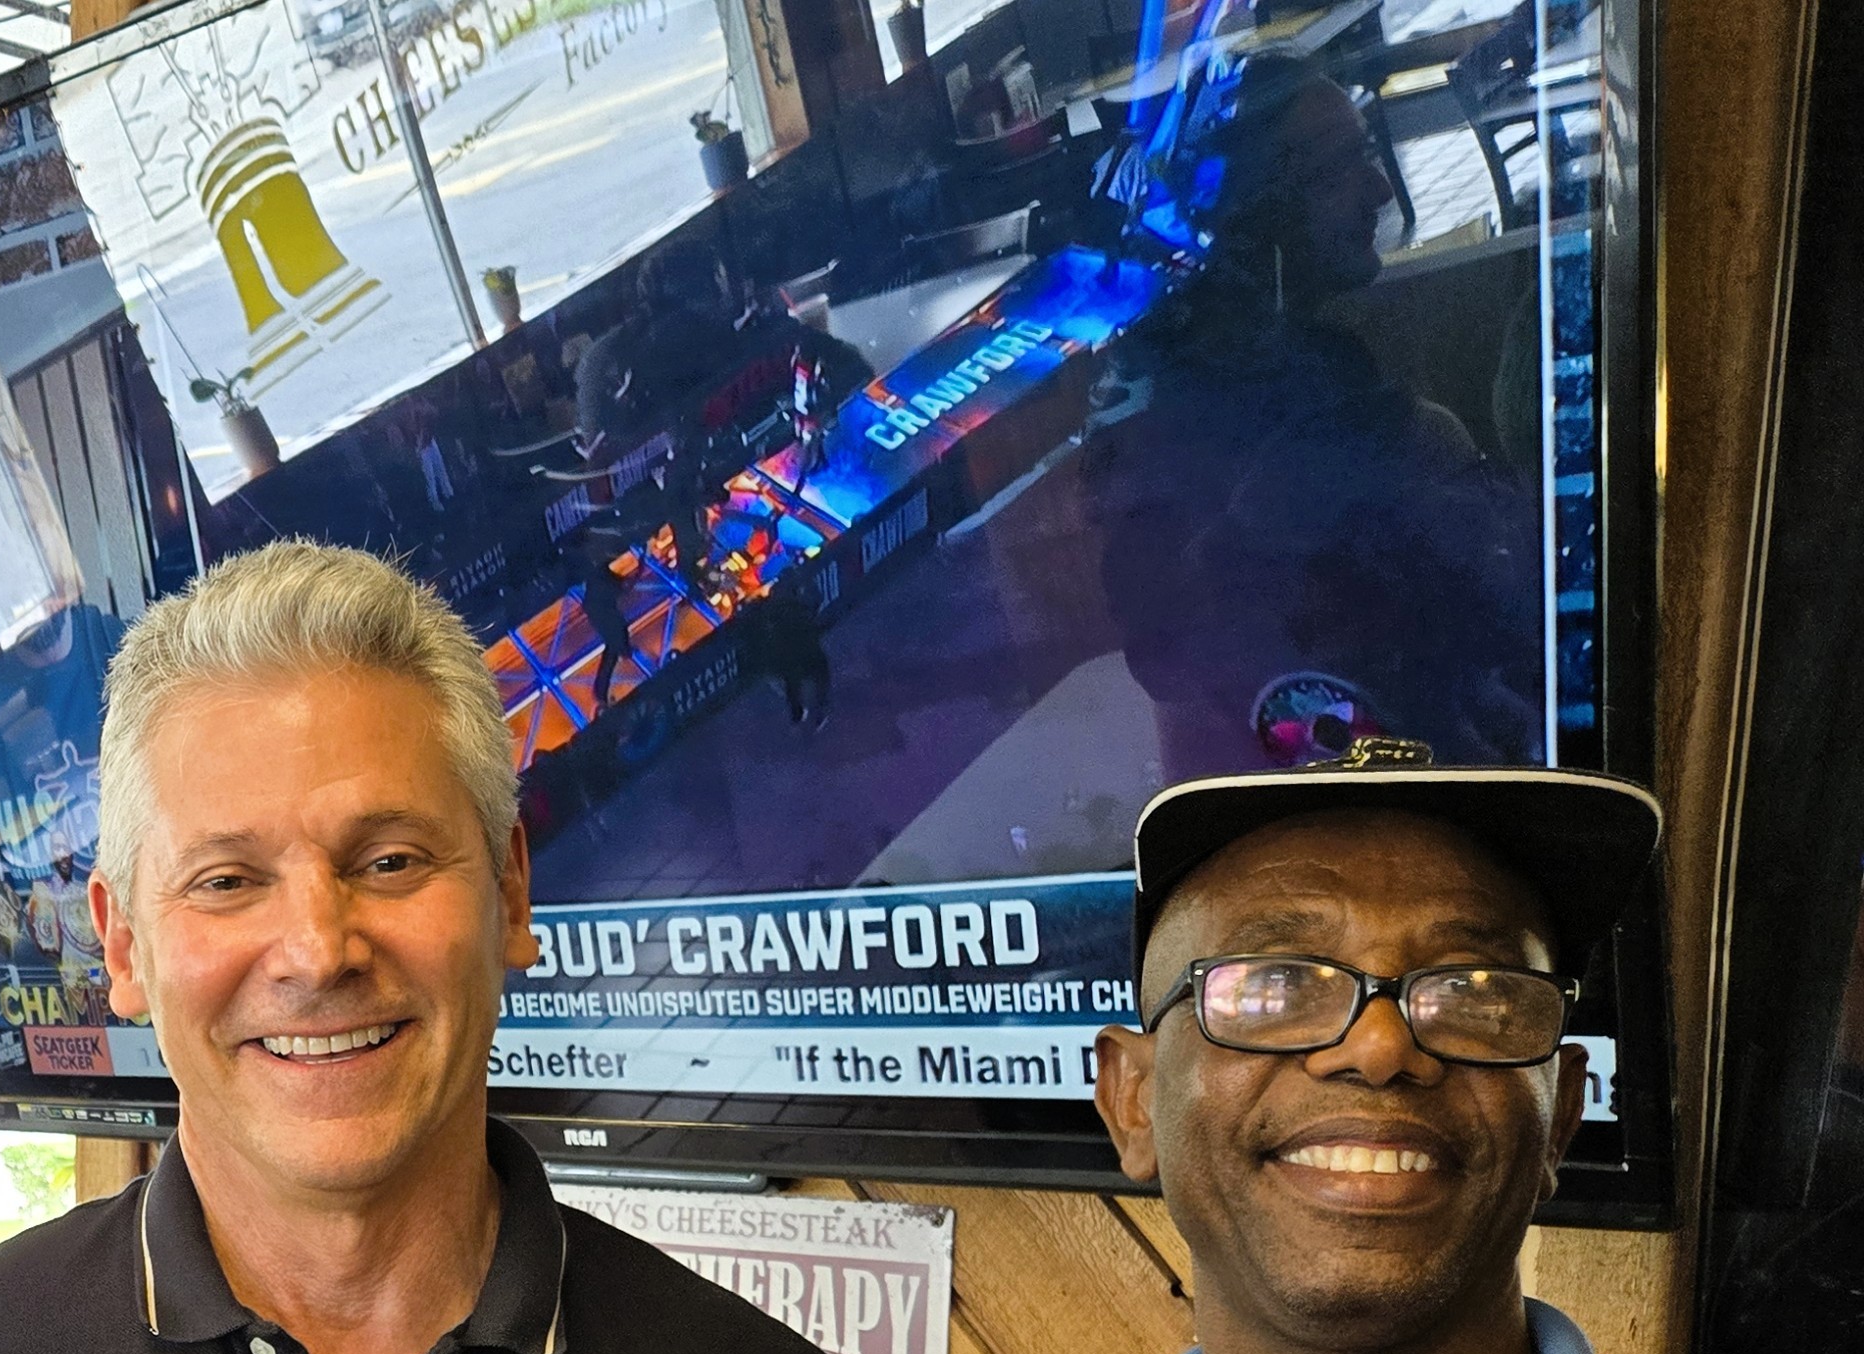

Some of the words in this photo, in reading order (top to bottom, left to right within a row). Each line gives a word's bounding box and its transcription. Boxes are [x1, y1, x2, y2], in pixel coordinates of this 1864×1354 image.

[865, 319, 1053, 450] CRAWFORD
[668, 900, 1039, 976] CRAWFORD
[0, 985, 151, 1027] CHAMP
[510, 990, 602, 1018] BECOME
[608, 986, 760, 1018] UNDISPUTED
[767, 984, 854, 1016] SUPER
[860, 980, 1084, 1015] MIDDLEWEIGHT
[33, 1034, 104, 1058] SEATGEEK
[49, 1054, 95, 1071] TICKER
[487, 1044, 627, 1078] Schefter
[776, 1047, 821, 1082] "If
[833, 1046, 902, 1083] the
[920, 1046, 1062, 1085] Miami
[564, 1129, 607, 1147] RCA
[568, 1196, 649, 1230] KY'S
[656, 1203, 896, 1250] CHEESESTEAK
